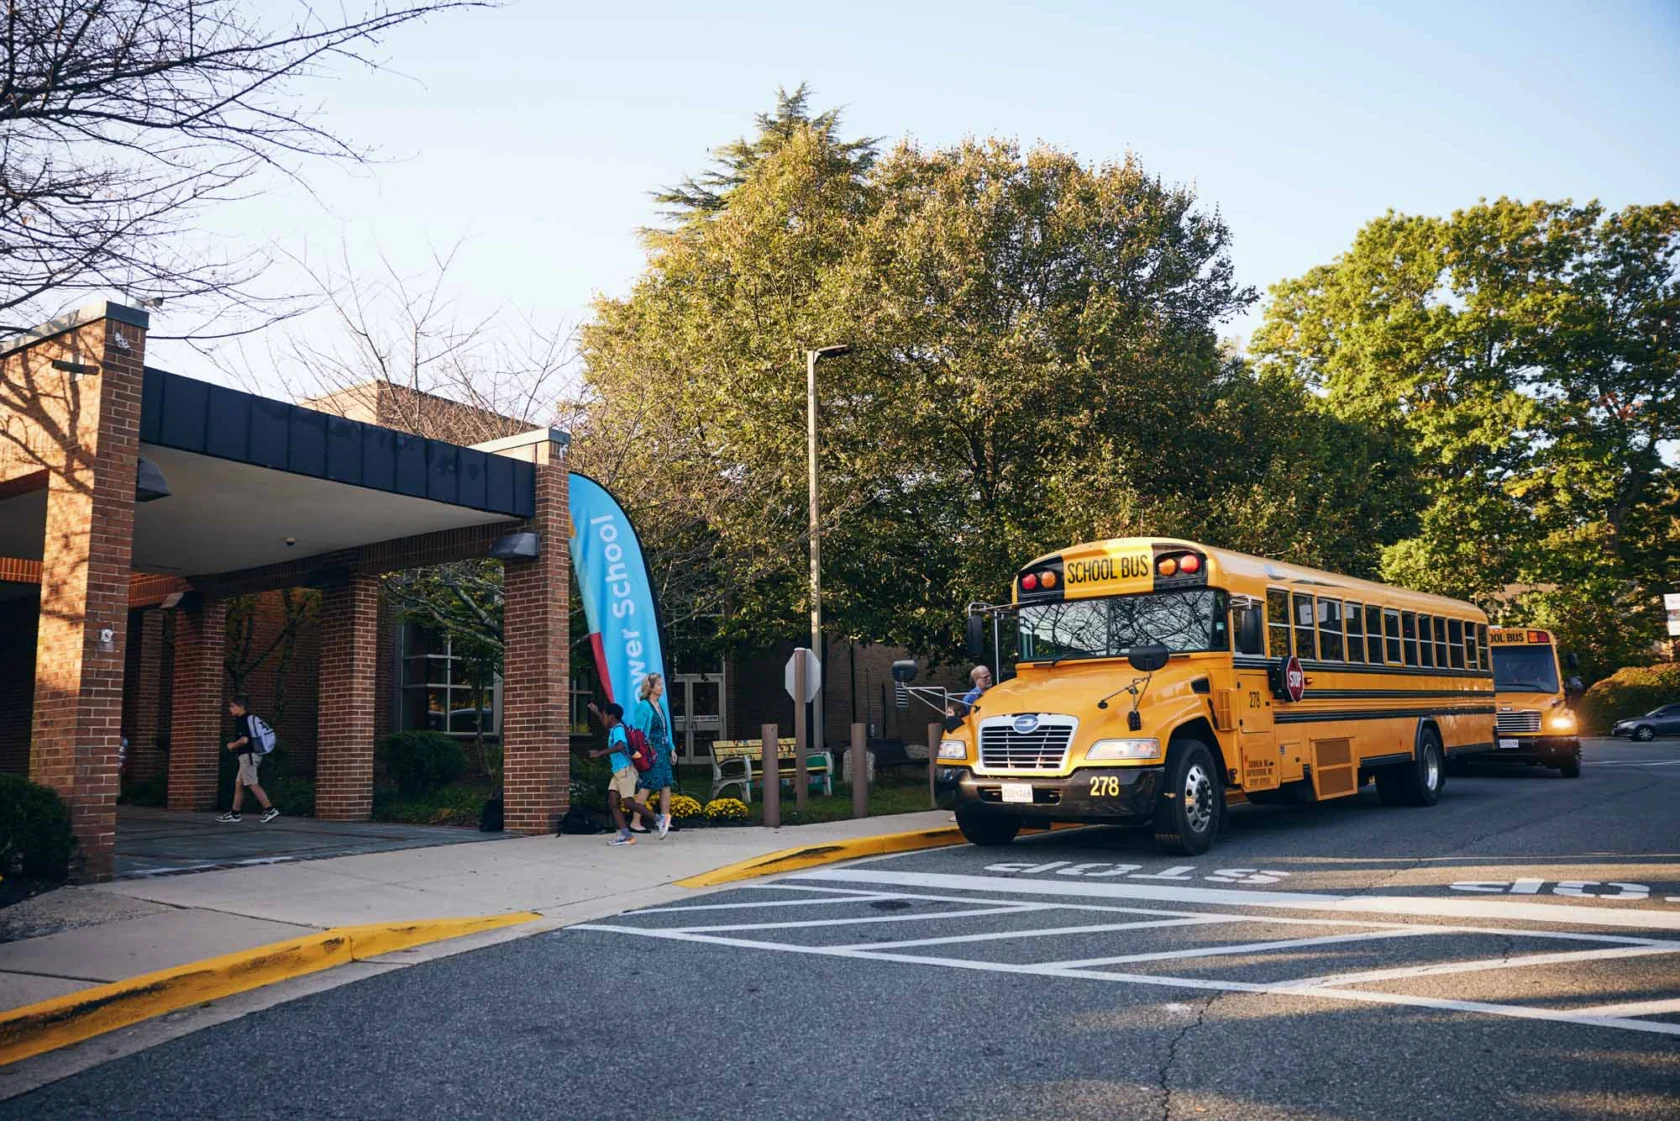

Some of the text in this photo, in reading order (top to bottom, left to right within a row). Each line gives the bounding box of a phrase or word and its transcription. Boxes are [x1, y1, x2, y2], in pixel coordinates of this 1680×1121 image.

[590, 514, 635, 619] School
[1067, 554, 1149, 584] SCHOOL BUS
[1506, 633, 1524, 643] BUS
[1289, 671, 1302, 688] STOP
[1249, 691, 1260, 708] 278
[1090, 776, 1119, 796] 278
[983, 861, 1291, 884] STOP
[1450, 878, 1680, 902] OP
